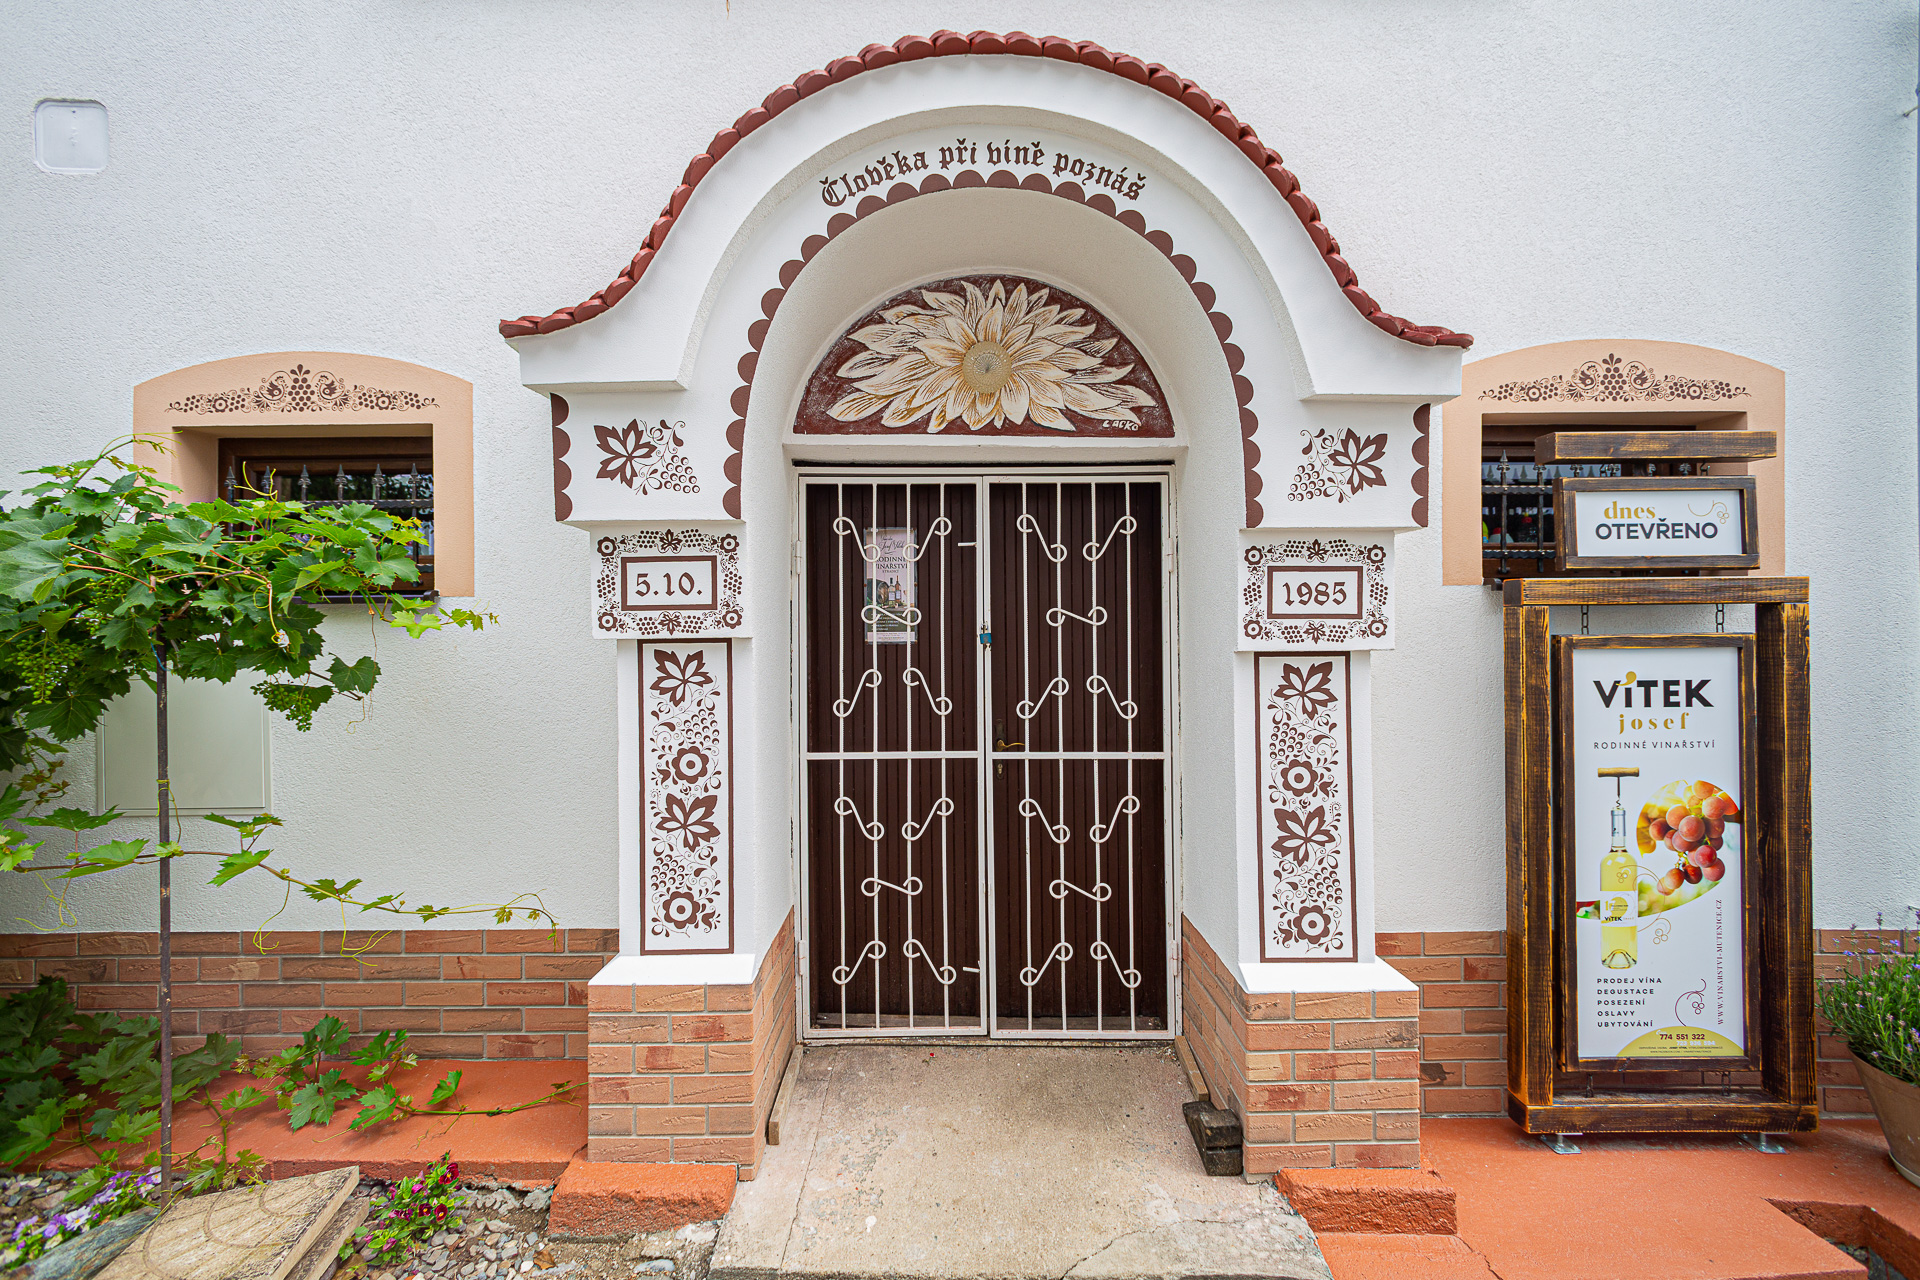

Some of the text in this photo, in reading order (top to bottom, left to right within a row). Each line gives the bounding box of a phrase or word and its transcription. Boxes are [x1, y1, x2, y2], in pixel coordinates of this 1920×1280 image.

[818, 138, 1147, 208] Člověka při víně poznáš
[1603, 501, 1656, 520] dnes
[1595, 518, 1718, 540] OTEVŘENO
[635, 572, 702, 597] 5.10.
[1282, 581, 1347, 606] 1985
[1619, 712, 1690, 735] josef
[1594, 739, 1715, 749] RODINNÉ VINAŘSTVÍ
[1716, 899, 1724, 1025] WWW.VINARSTVI-MUTENICE.CZ
[1639, 976, 1662, 984] VÍNA
[1597, 998, 1646, 1006] POSEZENÍ
[1597, 1019, 1653, 1027] UBYTOVÁNÍ
